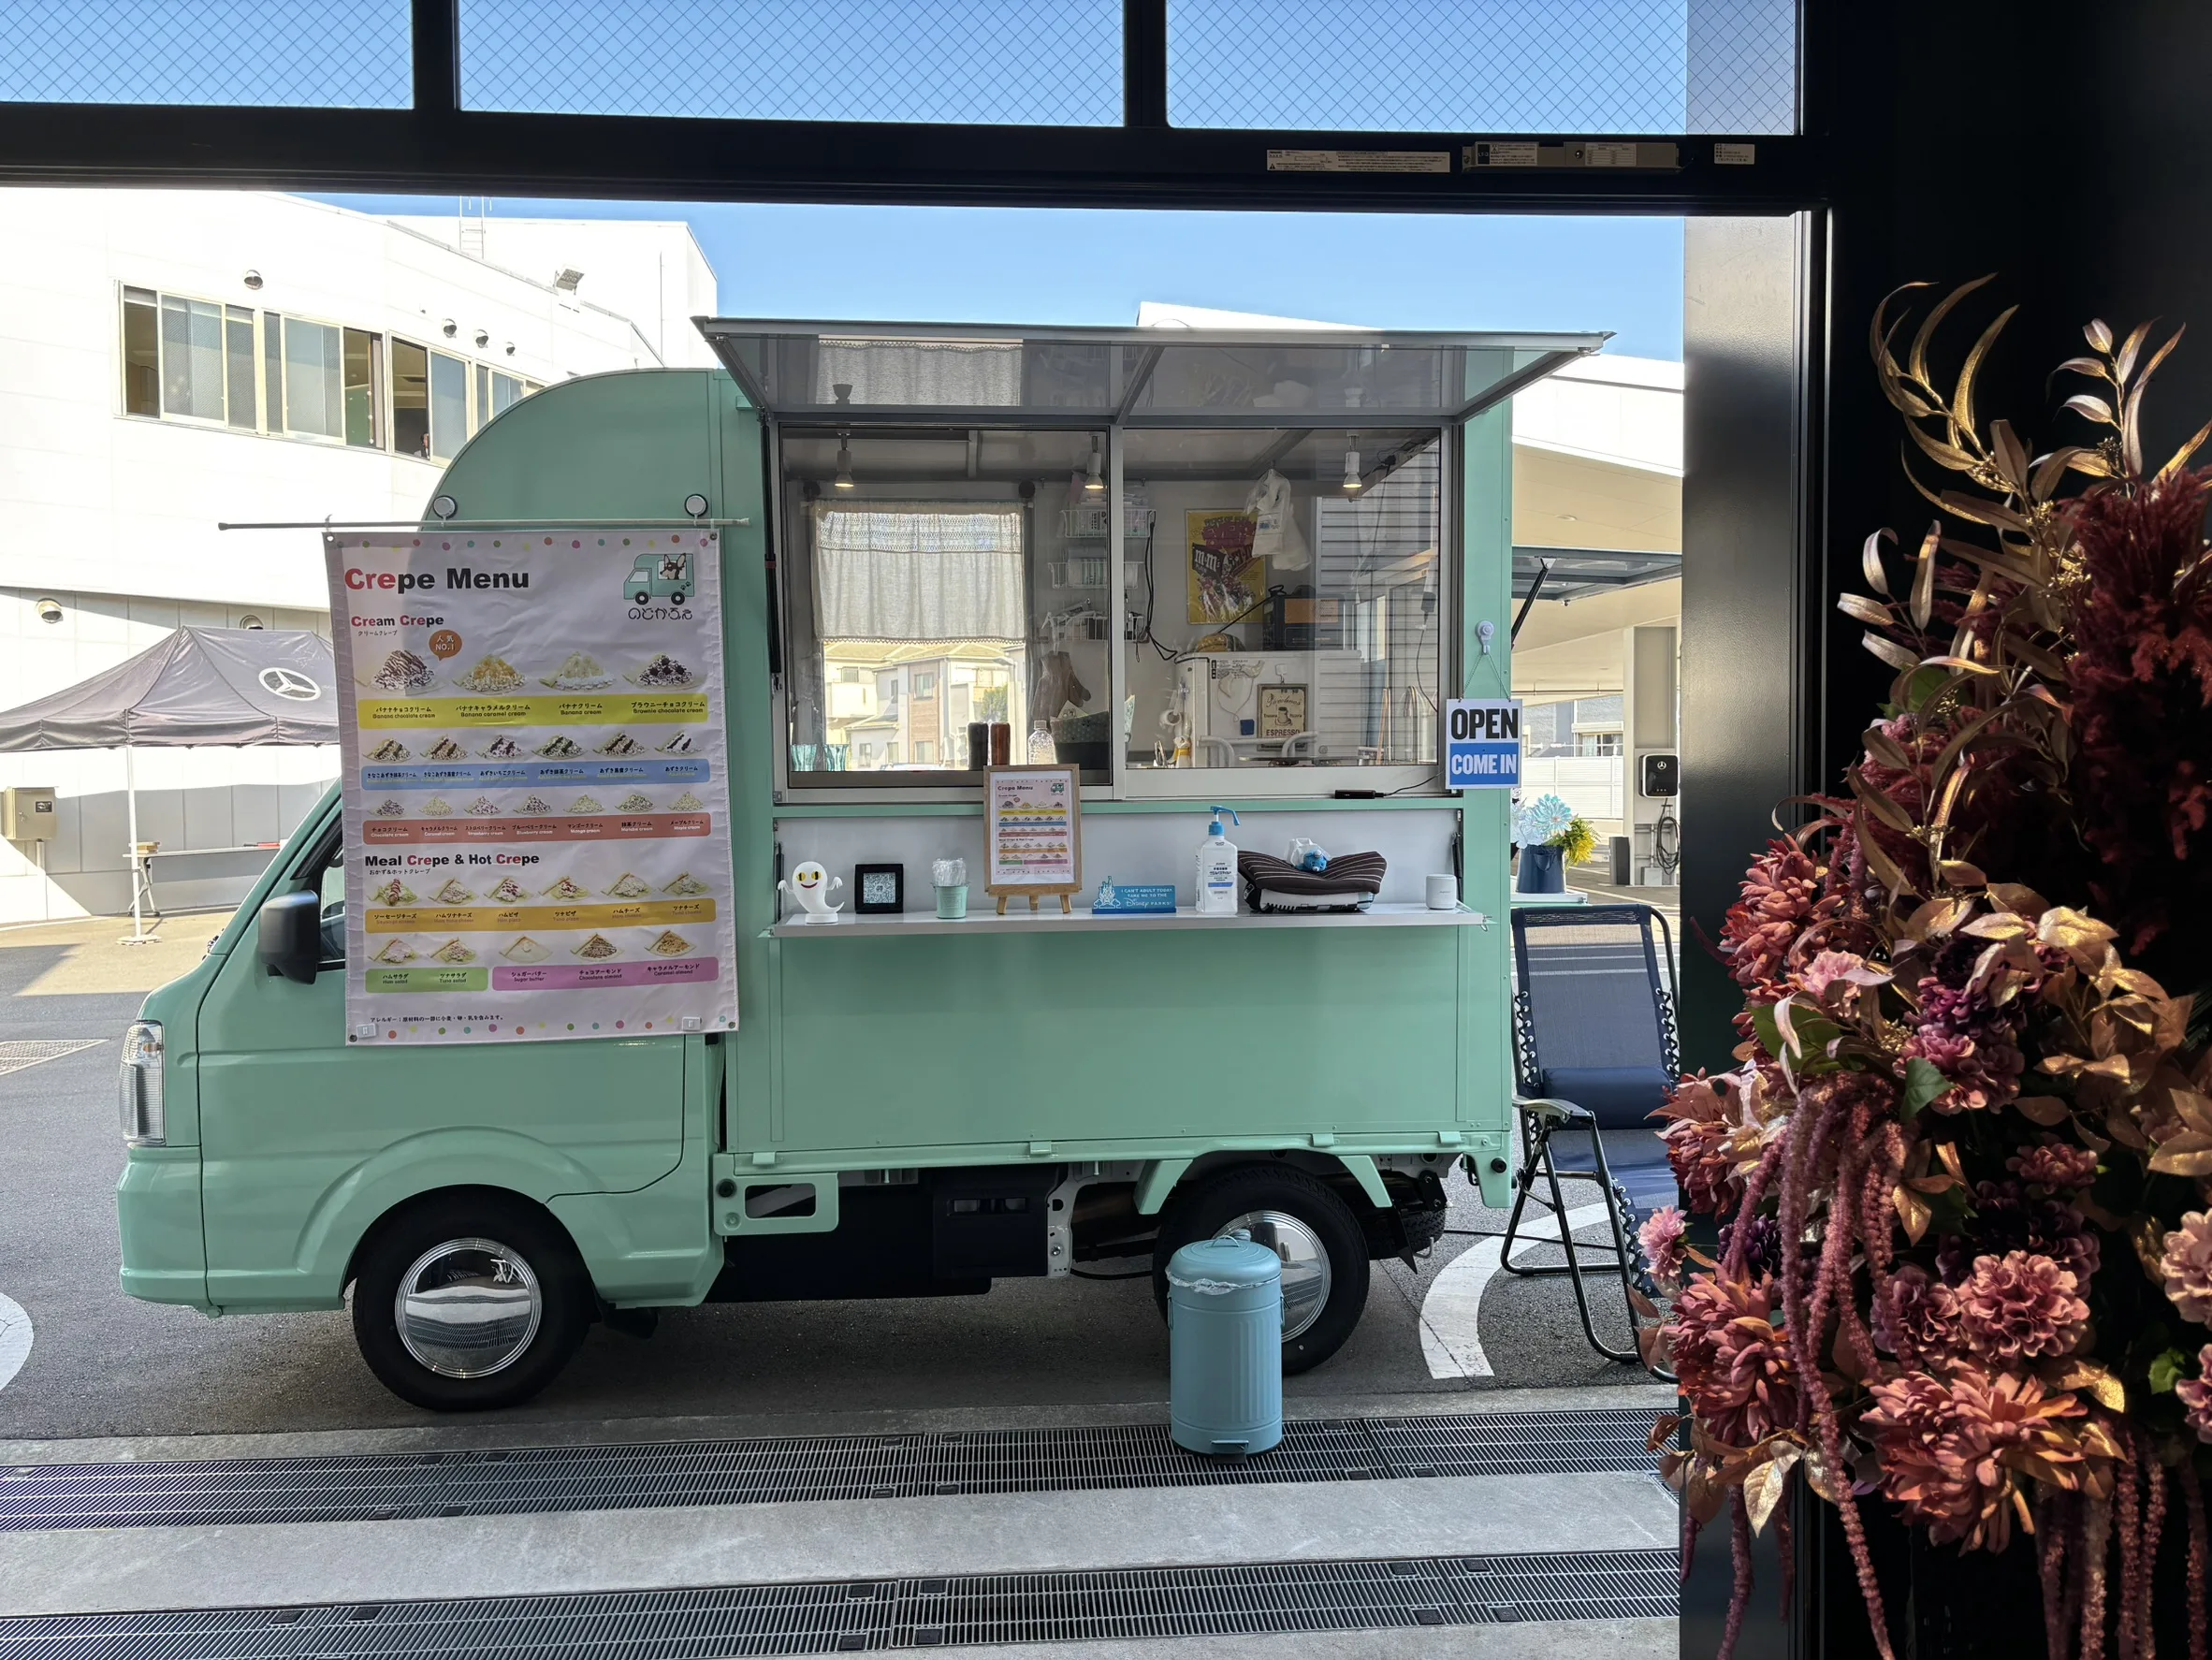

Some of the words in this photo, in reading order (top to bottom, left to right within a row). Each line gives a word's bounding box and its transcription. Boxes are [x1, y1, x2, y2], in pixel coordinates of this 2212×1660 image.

[344, 567, 435, 594] Crepe
[446, 568, 530, 590] Menu
[351, 616, 395, 627] Cream
[400, 615, 444, 628] Crepe
[1451, 708, 1519, 740] OPEN
[1451, 754, 1498, 775] COME
[1500, 753, 1517, 774] IN
[365, 855, 402, 866] Meal
[407, 854, 450, 867] Crepe
[455, 854, 465, 865] &
[469, 854, 492, 865] Hot
[496, 853, 540, 866] Crepe
[647, 963, 700, 972] キャラメルアーモンド
